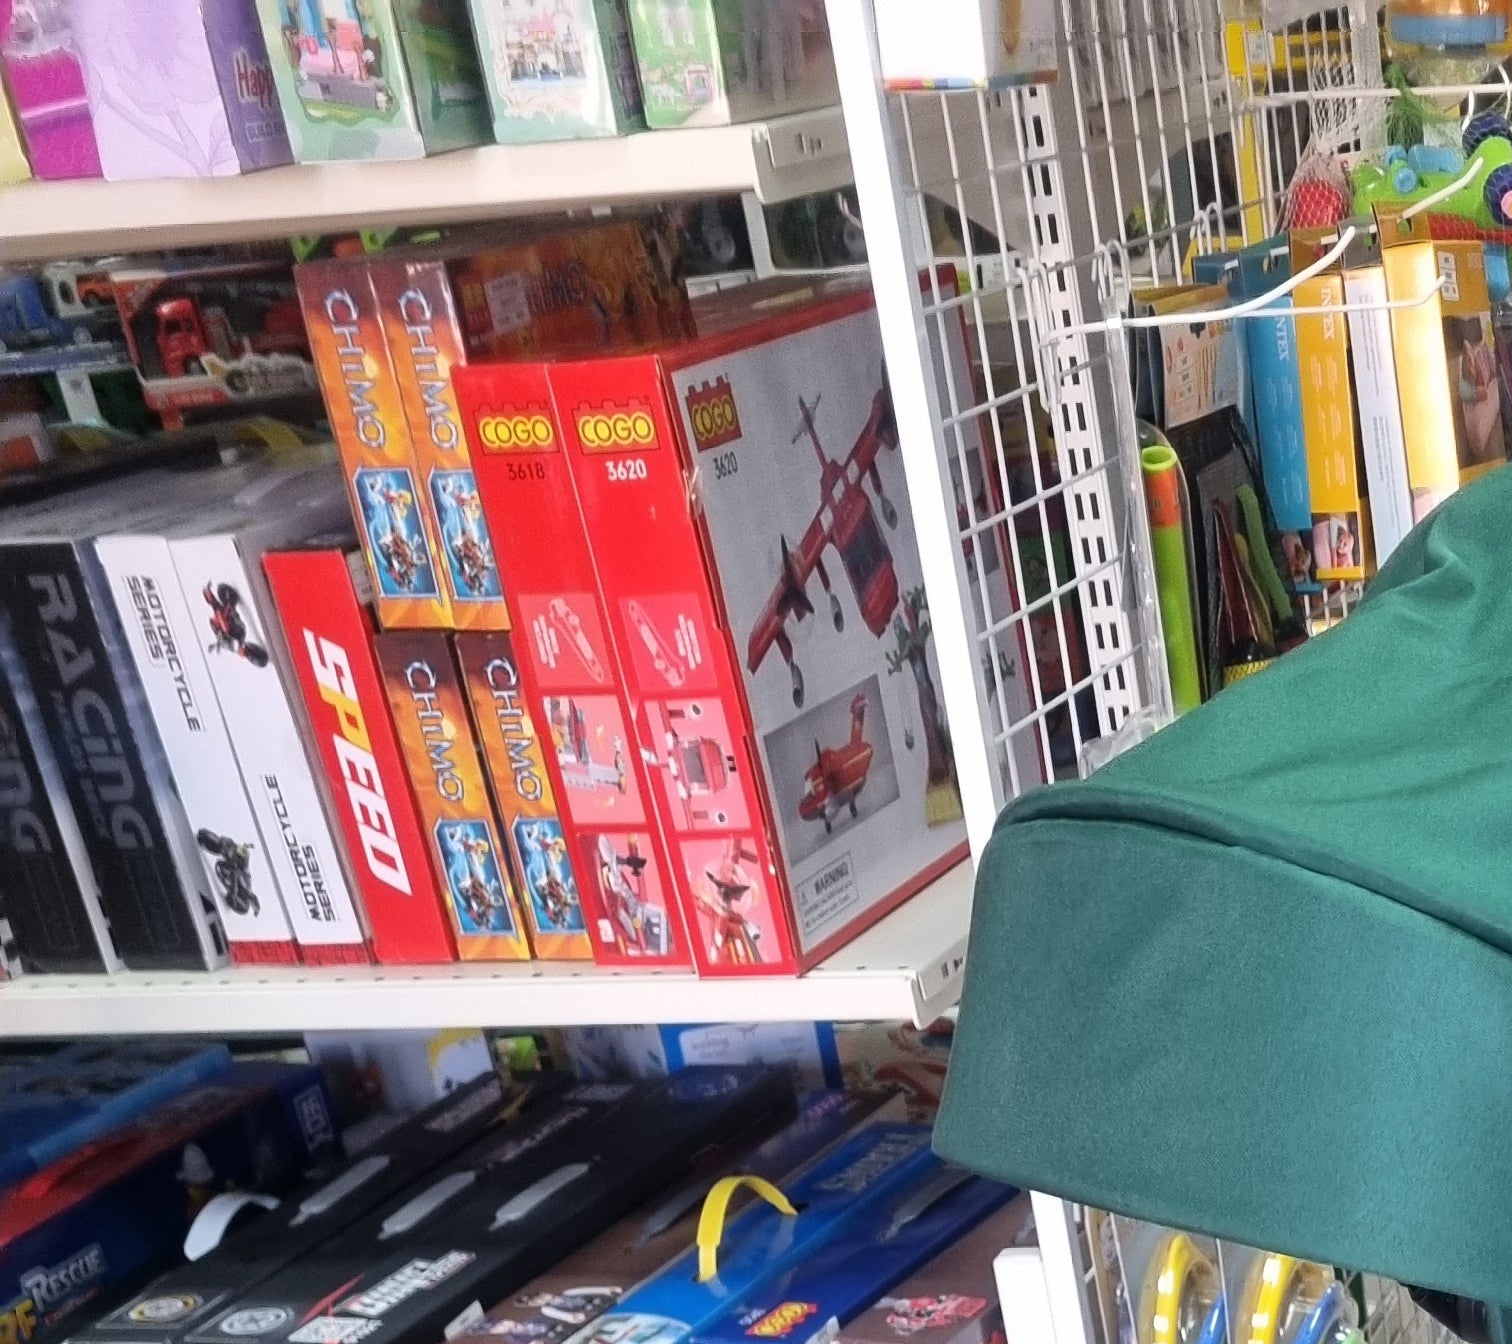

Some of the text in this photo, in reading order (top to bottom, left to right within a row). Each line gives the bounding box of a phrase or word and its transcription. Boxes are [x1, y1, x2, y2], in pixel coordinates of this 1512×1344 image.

[324, 288, 386, 448] CHIMO
[398, 287, 460, 449] CHIMO
[479, 414, 554, 448] COGO
[577, 410, 656, 448] COGO
[690, 395, 736, 442] COGO
[506, 462, 546, 482] 3618
[604, 458, 648, 482] 3620
[713, 451, 739, 481] 3620
[126, 575, 164, 660] SERIES
[140, 575, 202, 732] MOTORCYCLE
[302, 628, 412, 896] SPEED
[404, 658, 465, 802] CHIMO
[483, 656, 544, 801] CHIMO
[264, 774, 321, 922] MOTORCYCLE
[301, 843, 336, 922] SERIES
